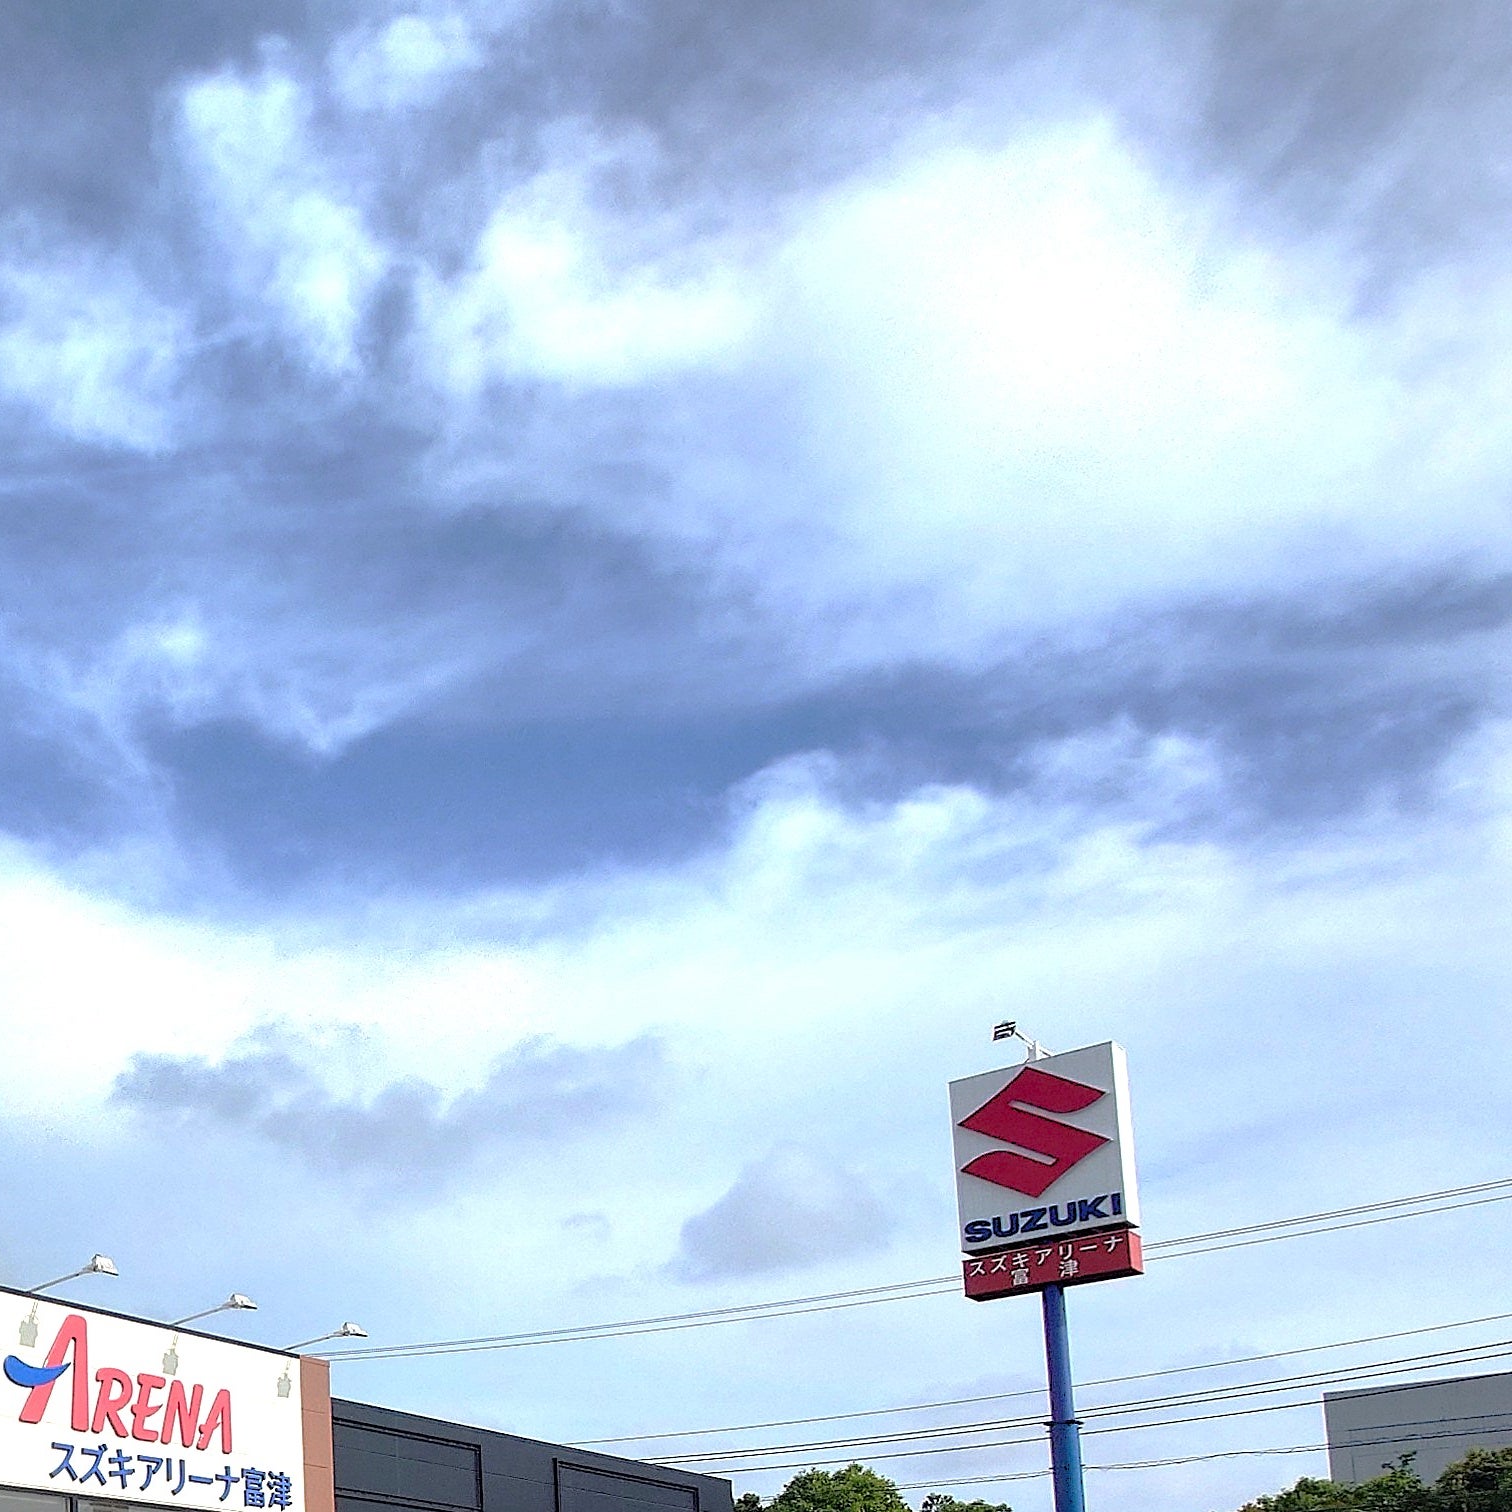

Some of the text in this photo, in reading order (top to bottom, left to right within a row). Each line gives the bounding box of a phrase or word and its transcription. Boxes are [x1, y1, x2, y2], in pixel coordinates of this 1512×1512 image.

[964, 1192, 1123, 1244] SUZUKI
[968, 1235, 1124, 1277] スズキアリーナ
[3, 1313, 233, 1455] ARENA
[49, 1441, 293, 1511] スズキアリーナ富津
